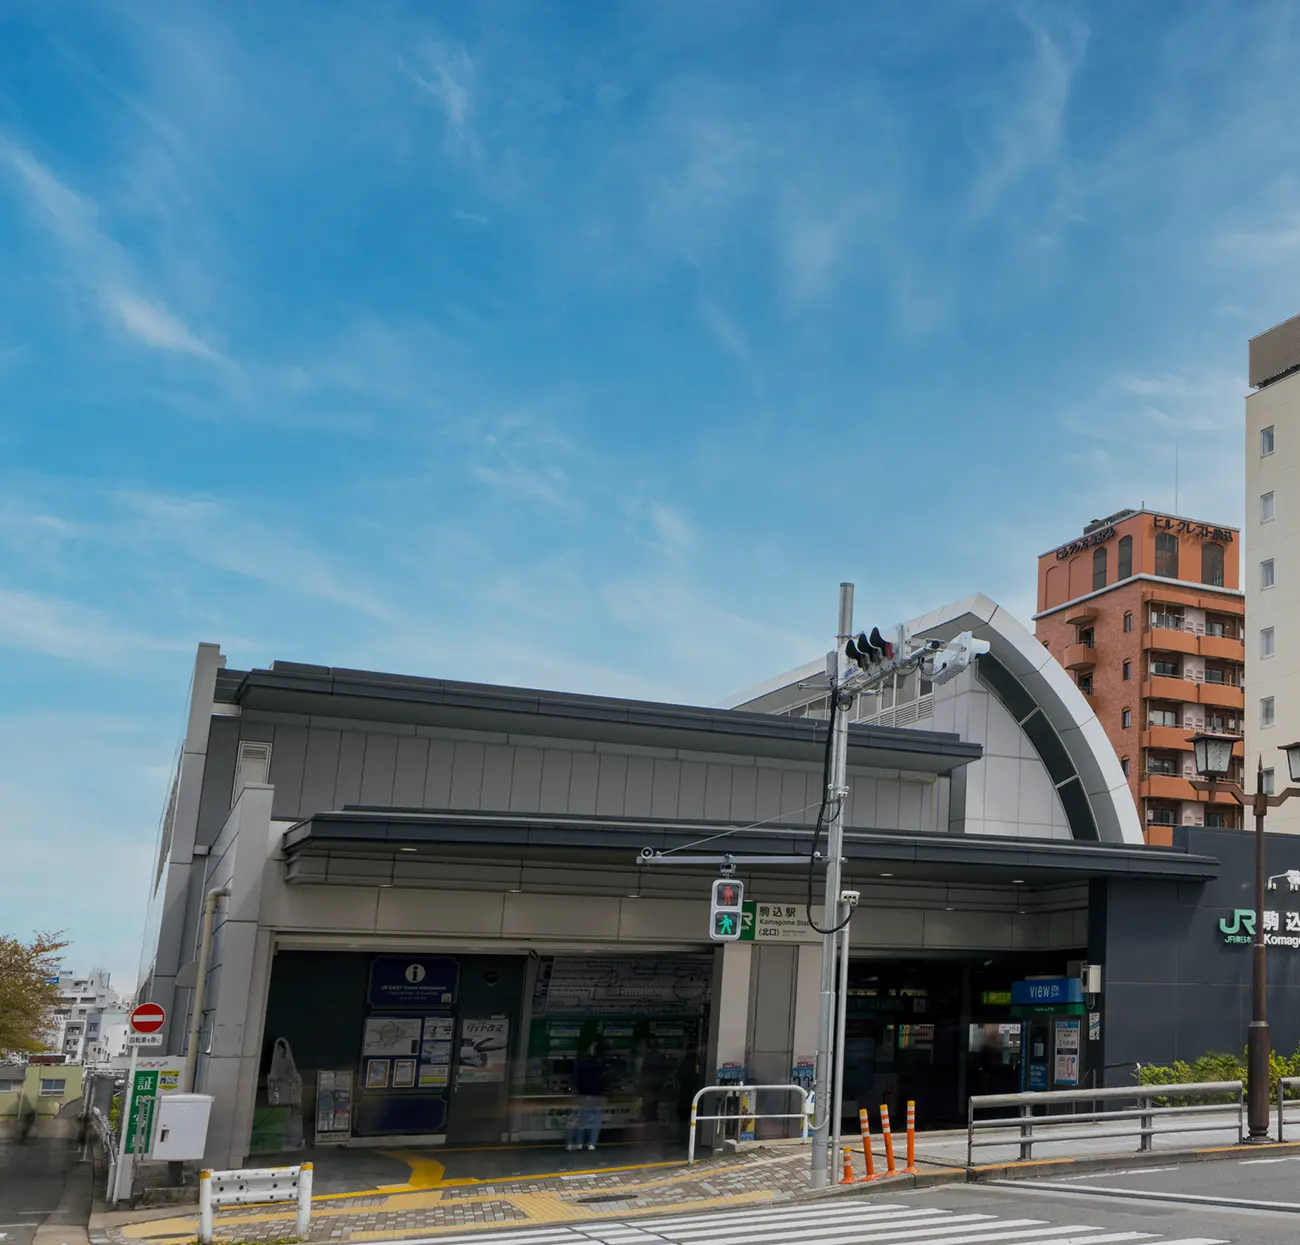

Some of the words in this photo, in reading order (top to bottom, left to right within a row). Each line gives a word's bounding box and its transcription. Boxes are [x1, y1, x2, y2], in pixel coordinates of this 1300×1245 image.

[758, 906, 796, 918] 駒込駅
[1219, 908, 1256, 935] JR
